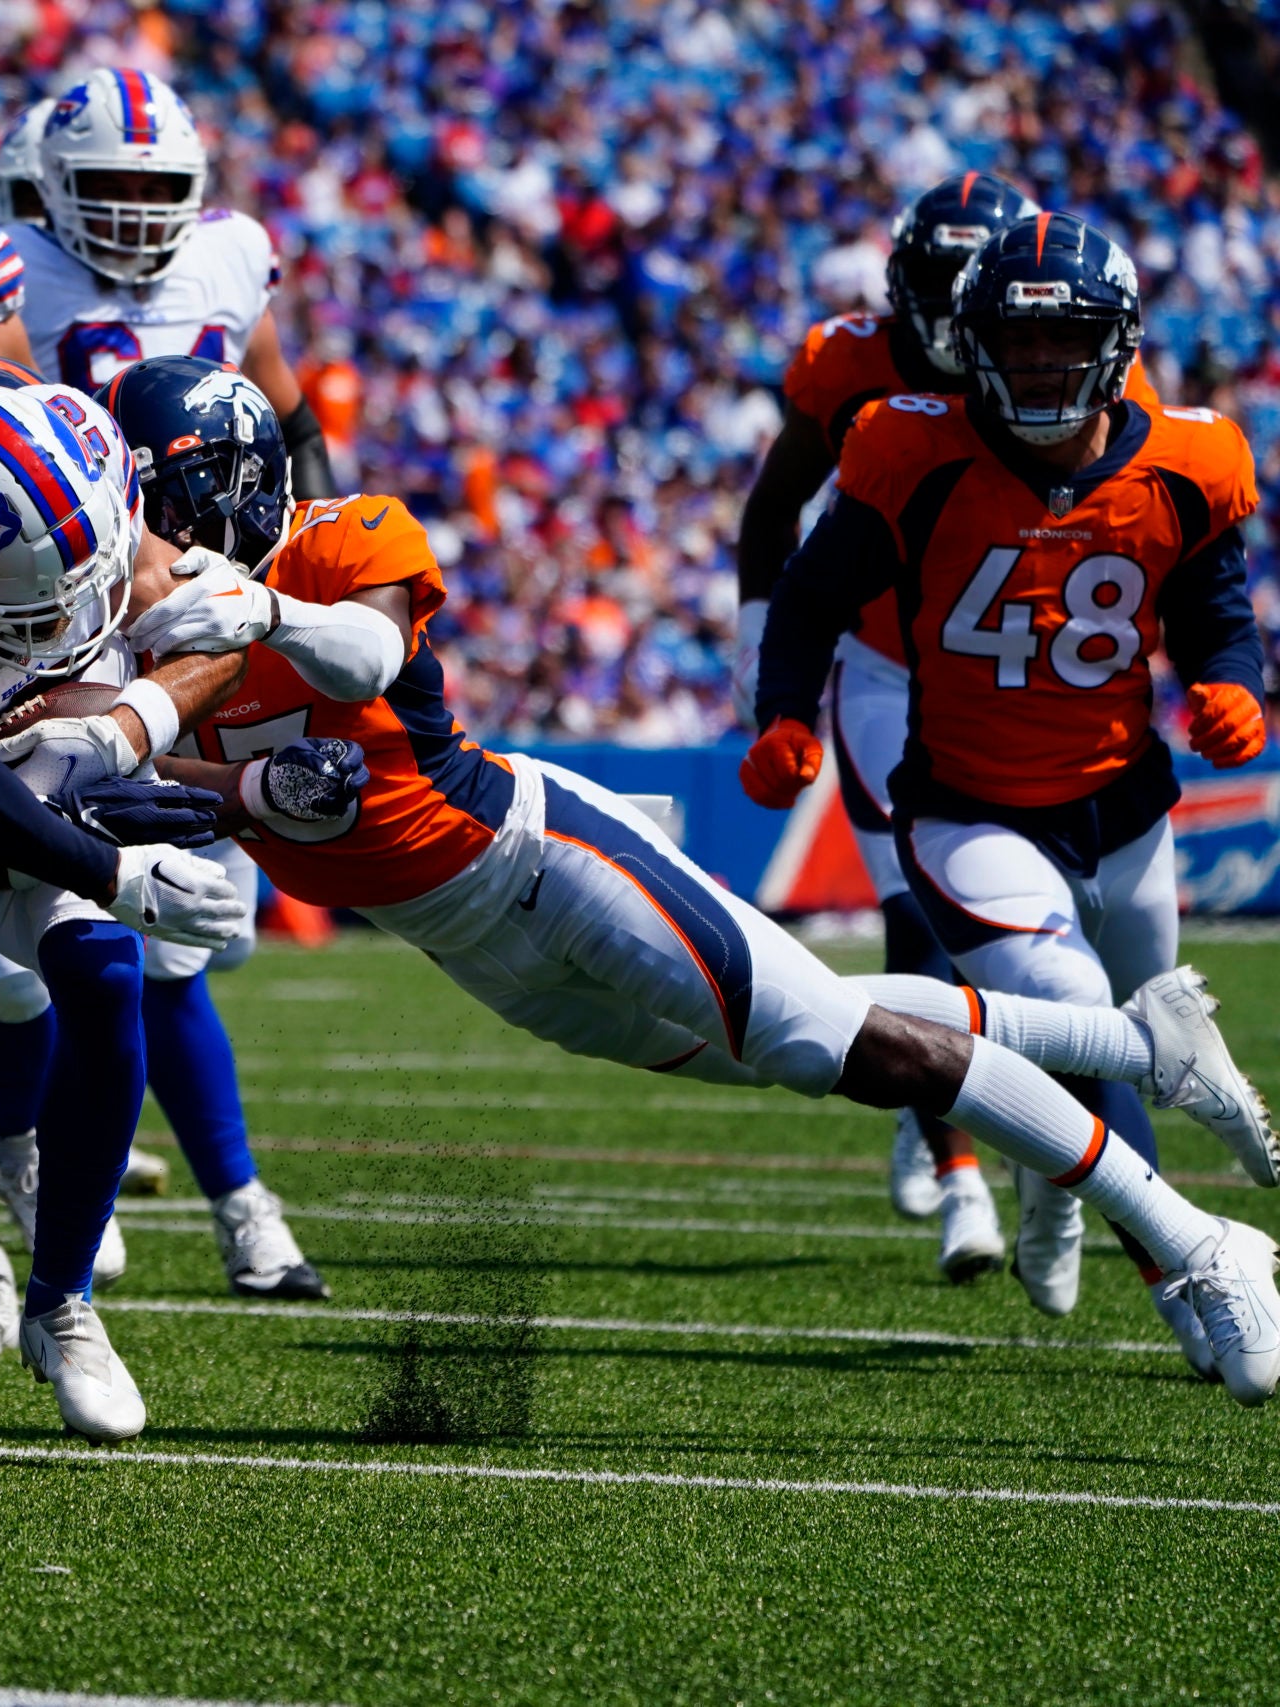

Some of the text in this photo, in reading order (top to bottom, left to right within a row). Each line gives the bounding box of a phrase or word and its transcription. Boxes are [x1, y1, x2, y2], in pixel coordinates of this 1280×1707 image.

[1019, 528, 1093, 541] BRONCOS
[939, 544, 1148, 690] 48
[214, 700, 262, 720] NCOS
